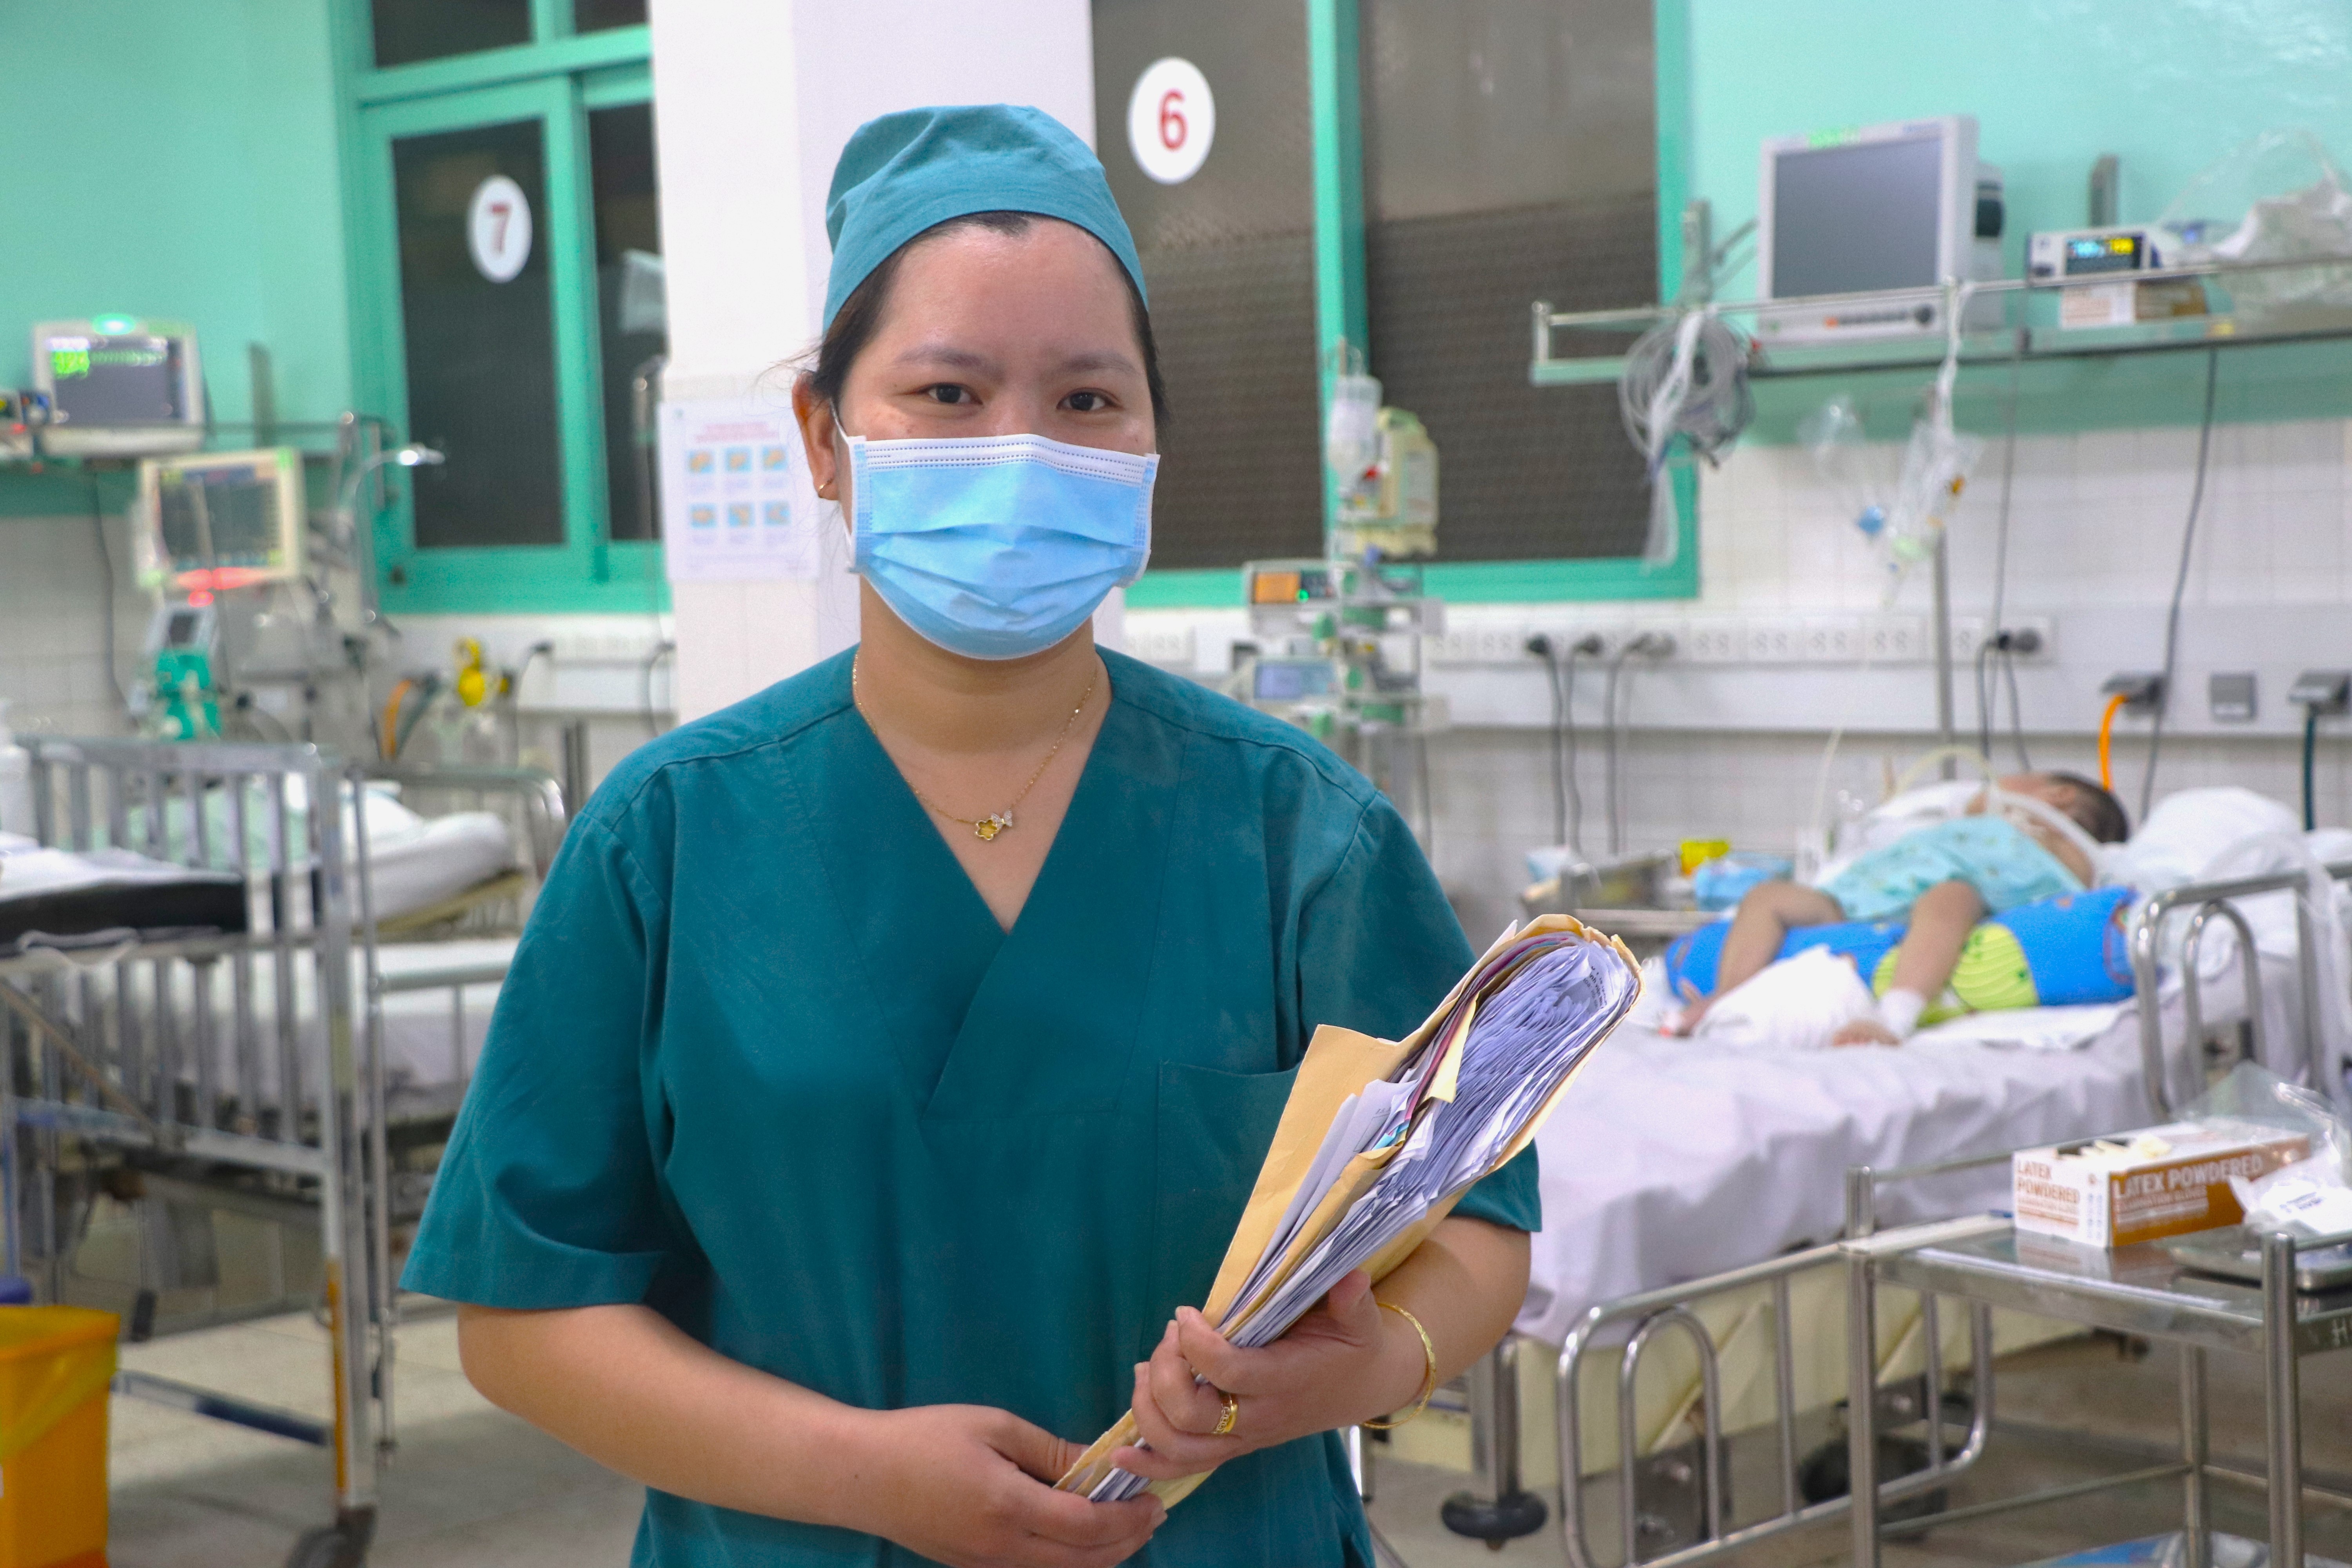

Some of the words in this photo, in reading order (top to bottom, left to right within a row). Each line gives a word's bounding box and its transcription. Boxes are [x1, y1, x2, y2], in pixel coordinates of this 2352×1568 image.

[1158, 88, 1189, 152] 6
[488, 202, 511, 256] 7
[2018, 1160, 2051, 1180] LATEX
[2018, 1178, 2080, 1204] POWDERED
[2111, 1172, 2165, 1198] LATEX
[2167, 1154, 2263, 1189] POWDERED
